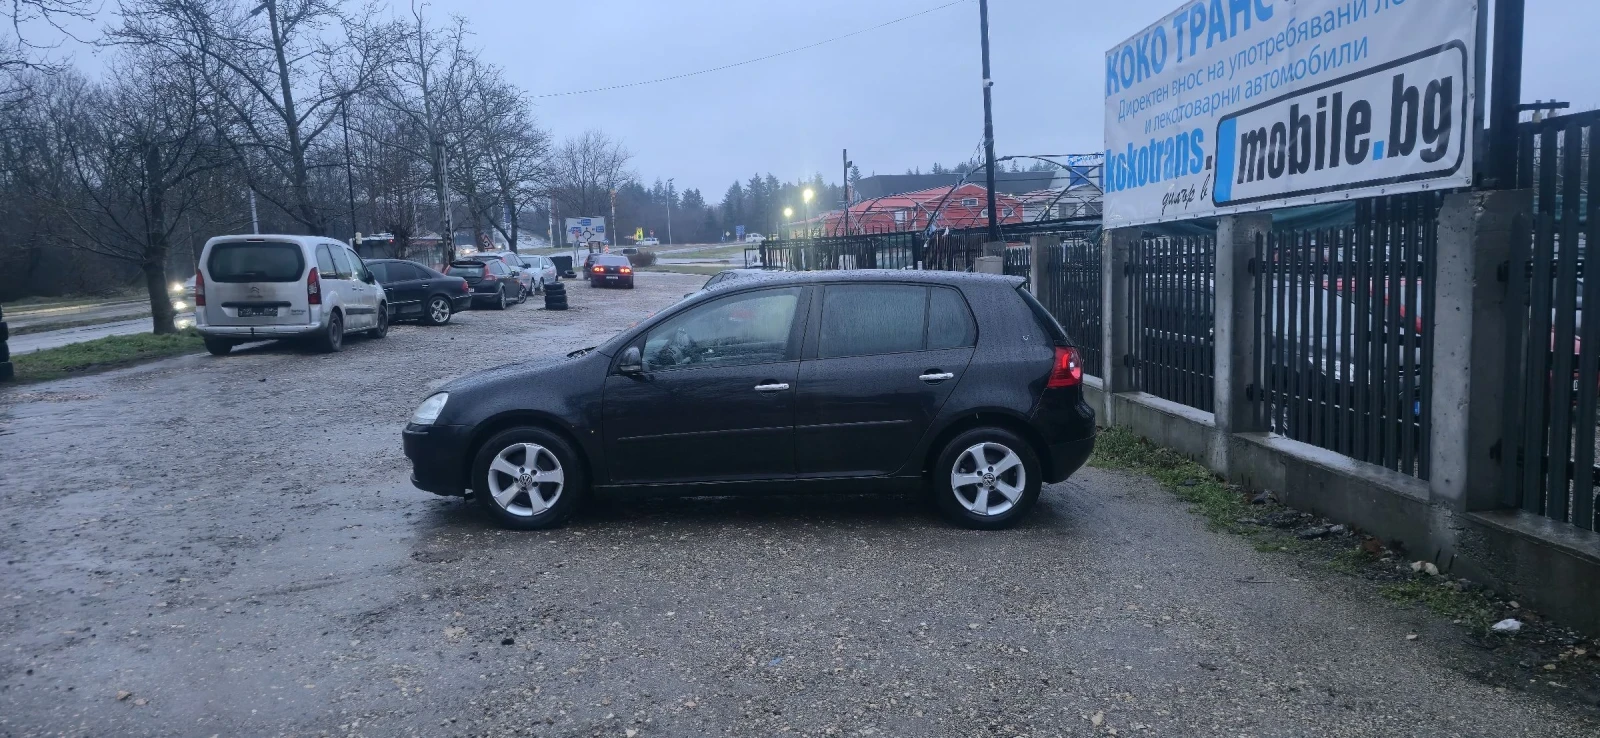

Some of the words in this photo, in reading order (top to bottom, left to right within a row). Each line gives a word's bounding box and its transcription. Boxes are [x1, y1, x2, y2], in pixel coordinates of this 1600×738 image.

[1106, 26, 1168, 97] КОКО
[1118, 84, 1169, 123] Директен
[1172, 69, 1204, 97] внос
[1208, 60, 1224, 82] на
[1229, 0, 1367, 80] употребявани
[1145, 119, 1152, 134] и
[1154, 86, 1241, 132] лекотоварни
[1245, 36, 1368, 99] автомобили
[1237, 73, 1453, 184] mobile.bg
